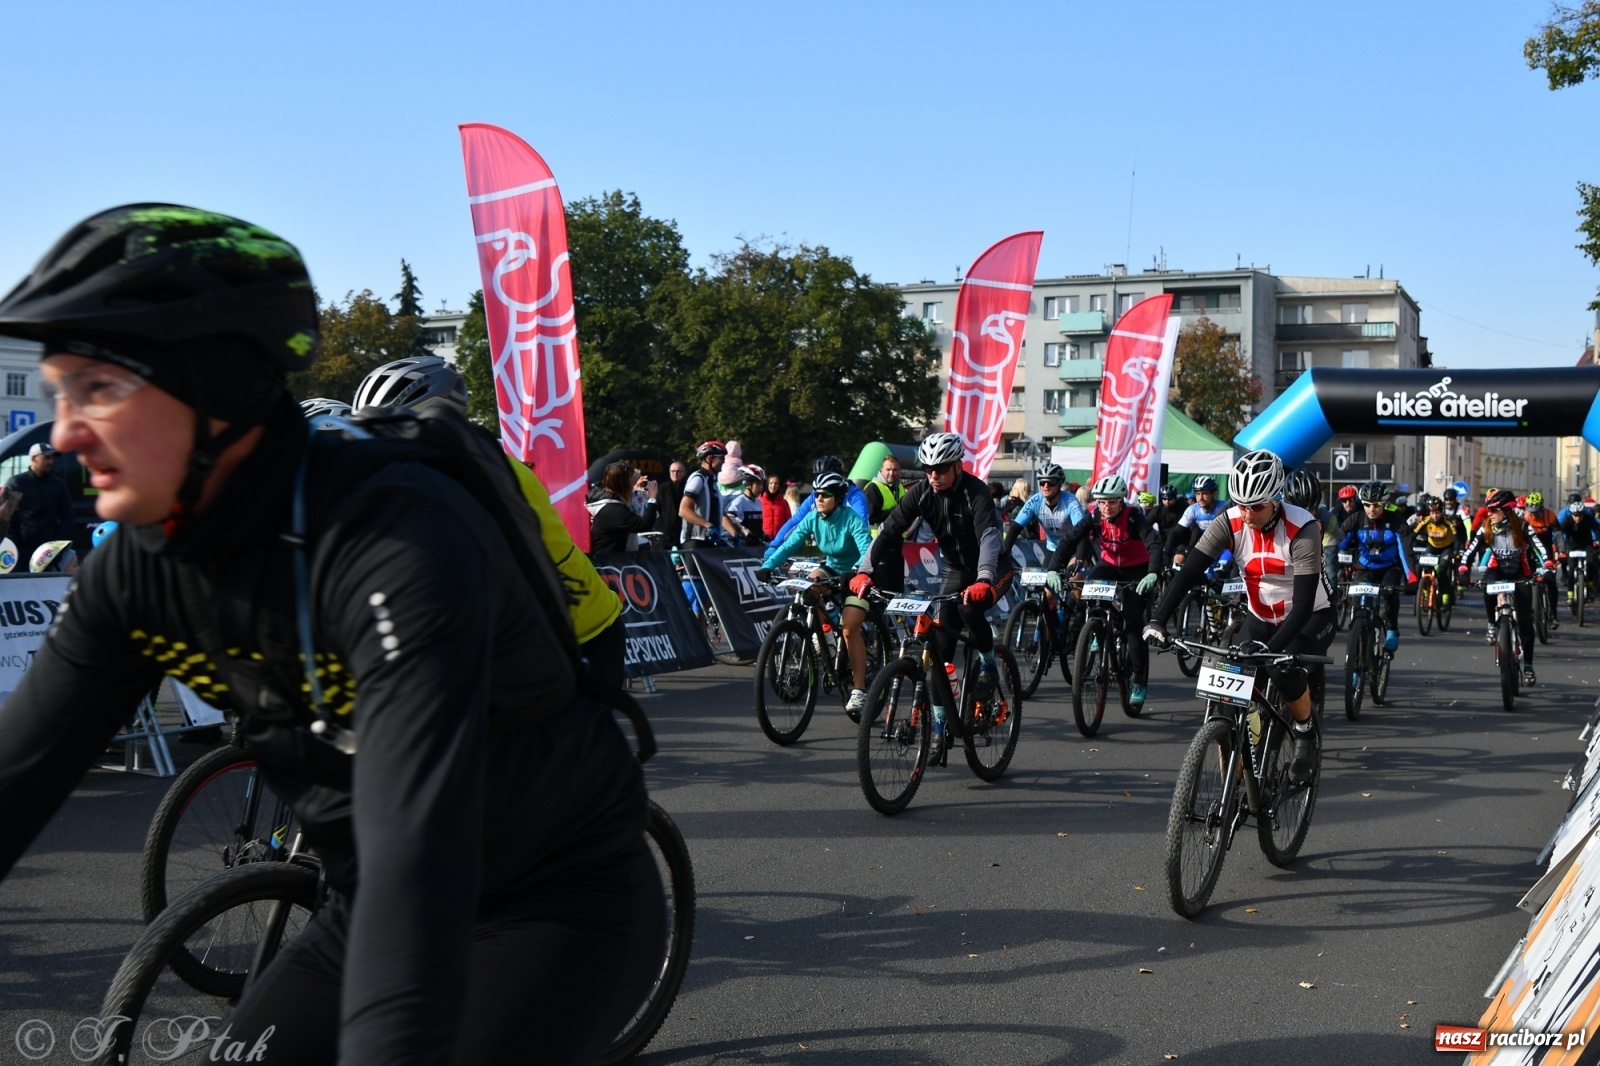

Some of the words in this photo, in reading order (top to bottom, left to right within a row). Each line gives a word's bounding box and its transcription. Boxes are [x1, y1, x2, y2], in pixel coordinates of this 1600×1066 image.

[1376, 391, 1433, 417] bike
[1439, 392, 1528, 418] atelier
[1088, 586, 1110, 594] 2909
[1228, 583, 1246, 591] 138
[894, 602, 923, 611] 1467
[1208, 674, 1245, 692] 1577
